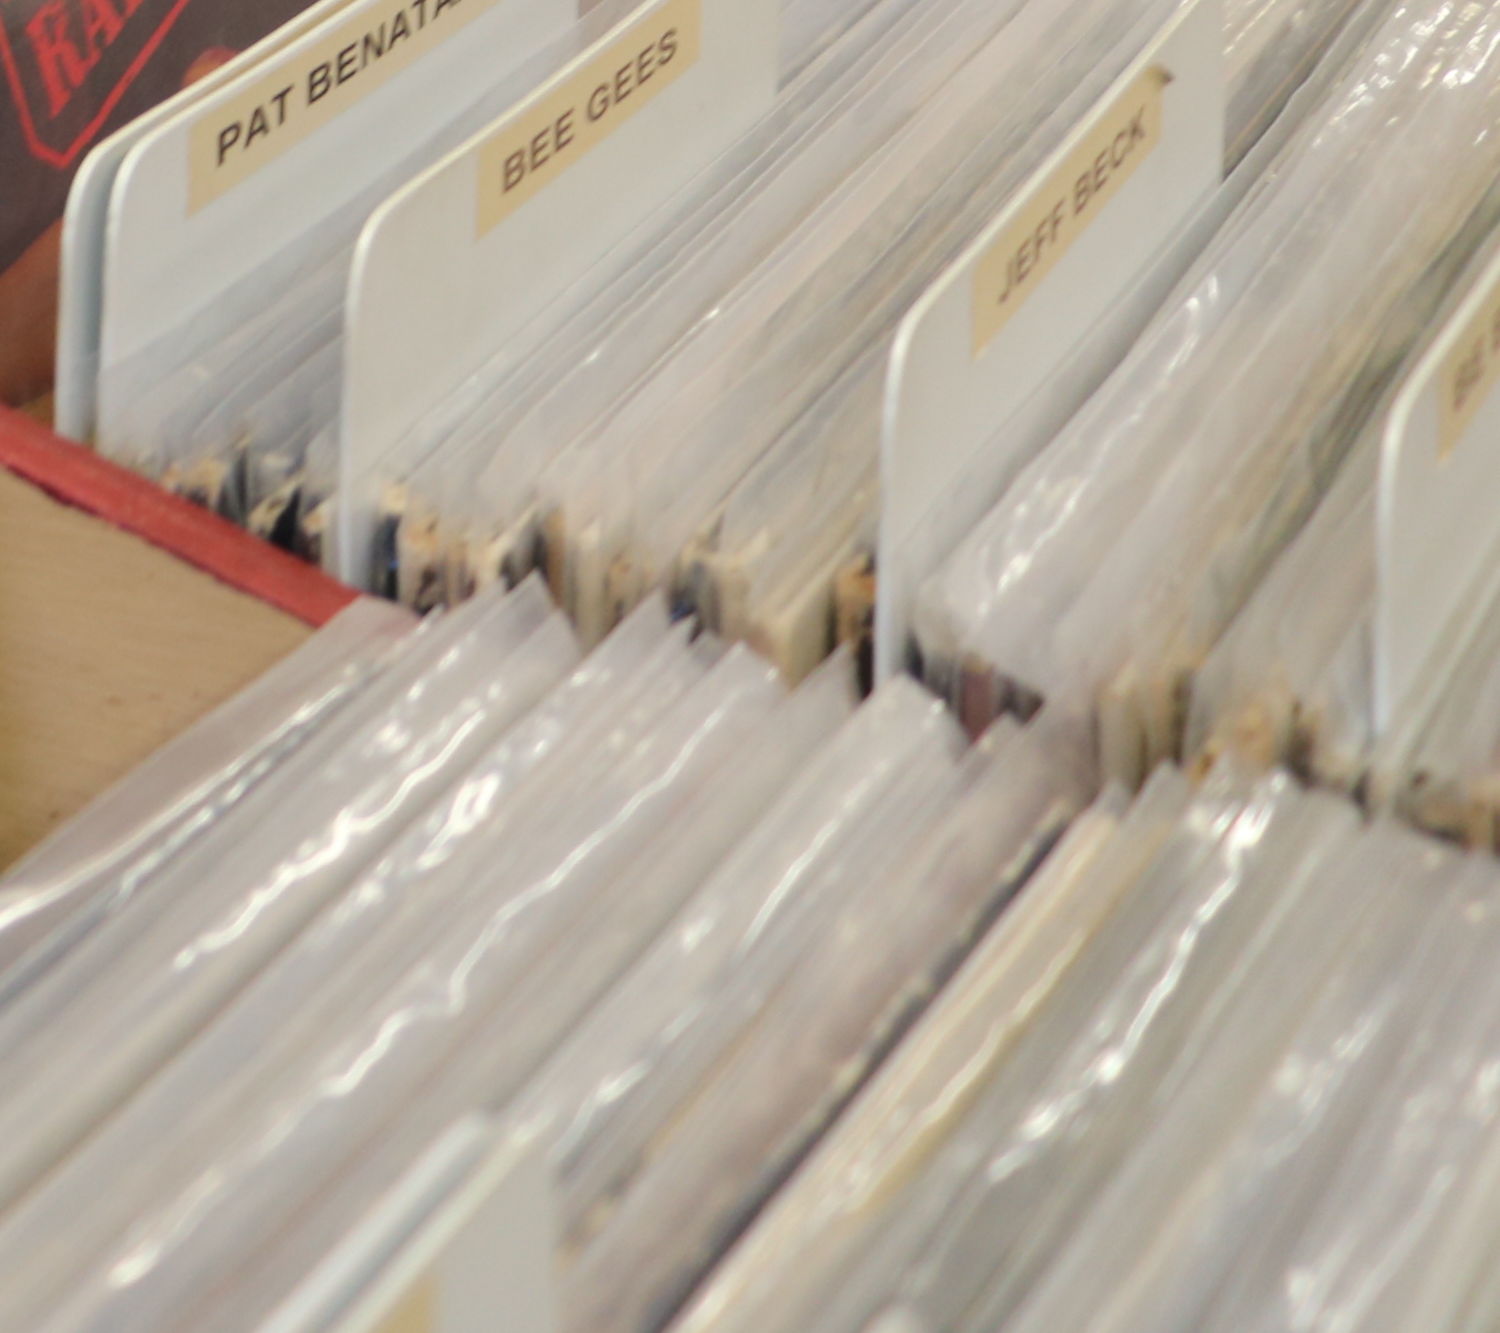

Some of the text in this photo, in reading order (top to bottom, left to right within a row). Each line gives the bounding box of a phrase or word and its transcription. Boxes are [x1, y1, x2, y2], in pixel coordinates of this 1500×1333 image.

[213, 83, 296, 169] PAT
[500, 24, 681, 197] BEE GEES
[993, 110, 1150, 309] JEFF BECK
